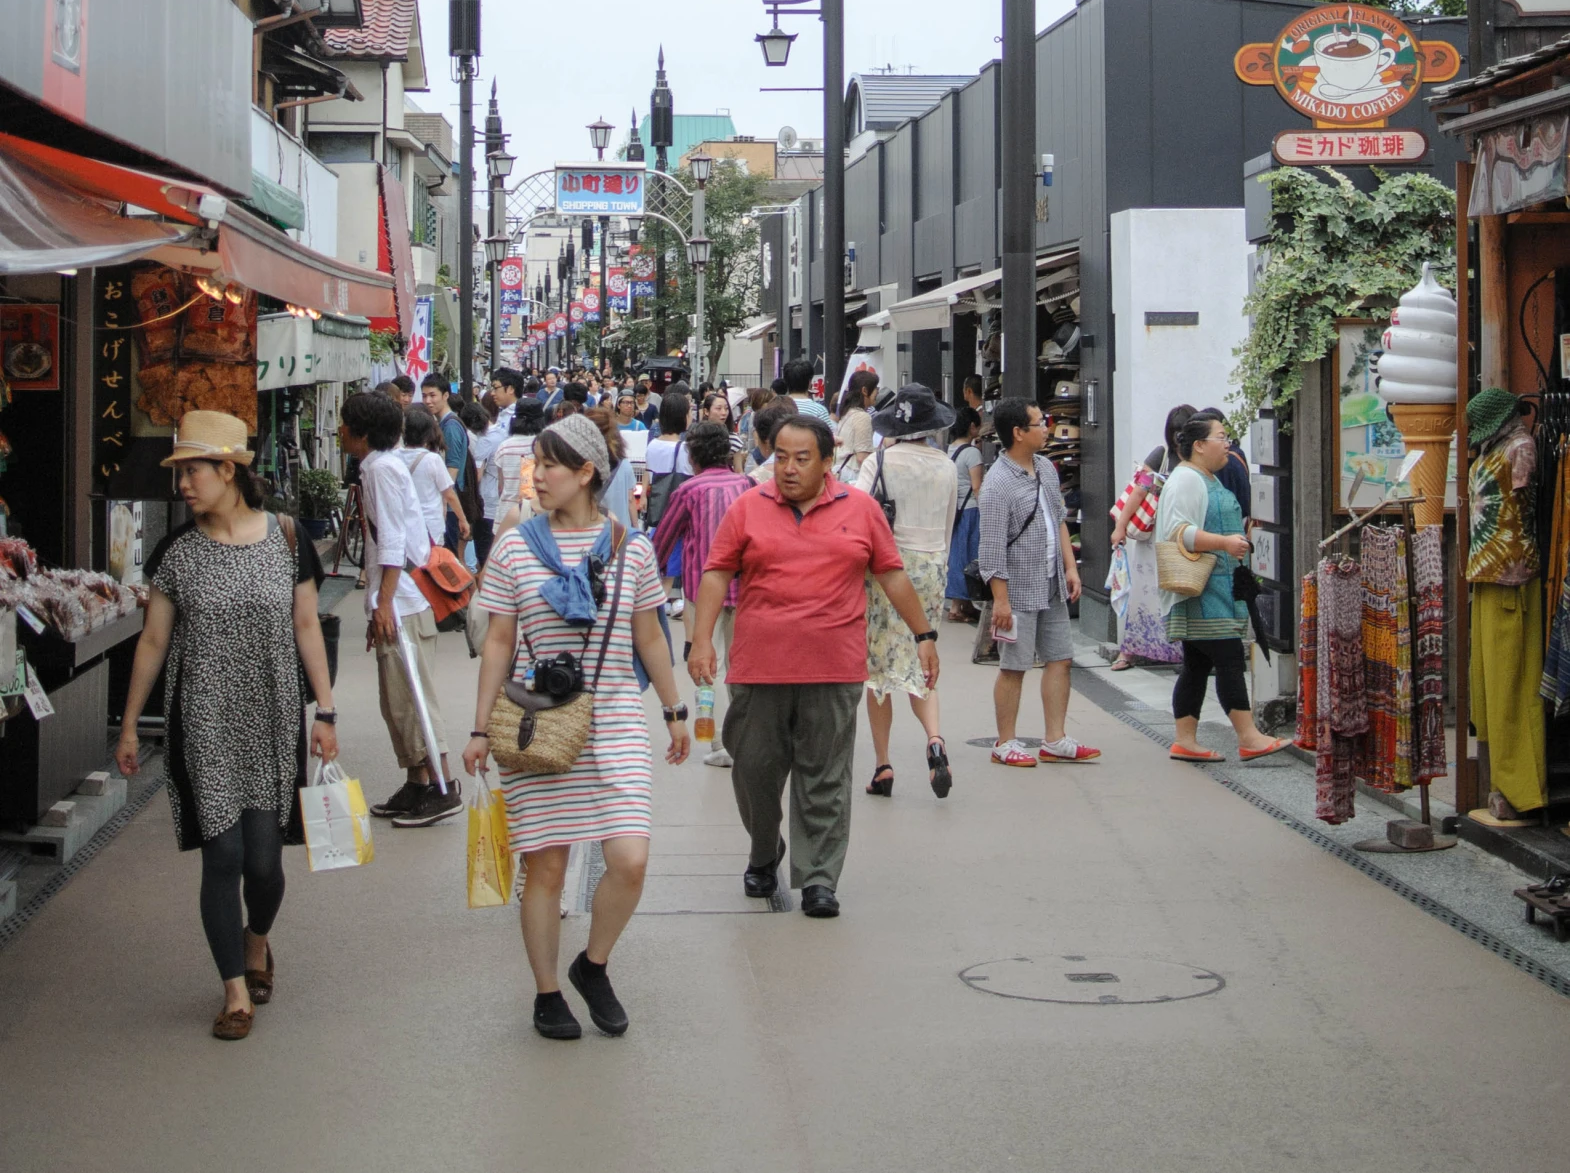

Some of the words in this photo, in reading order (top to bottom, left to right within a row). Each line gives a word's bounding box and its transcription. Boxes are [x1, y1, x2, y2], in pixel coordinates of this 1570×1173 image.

[1290, 9, 1341, 39] ORIGINAL
[1354, 10, 1399, 35] FLAVOR
[1291, 88, 1347, 119] MIKADO
[1351, 88, 1405, 119] COFFEE
[1296, 134, 1404, 157] ミカド珈琲
[561, 173, 639, 195] 小町通り
[562, 201, 608, 211] SHOPPING
[610, 201, 637, 211] TOWN
[405, 331, 429, 381] 氷
[102, 280, 125, 477] おこげせんべい
